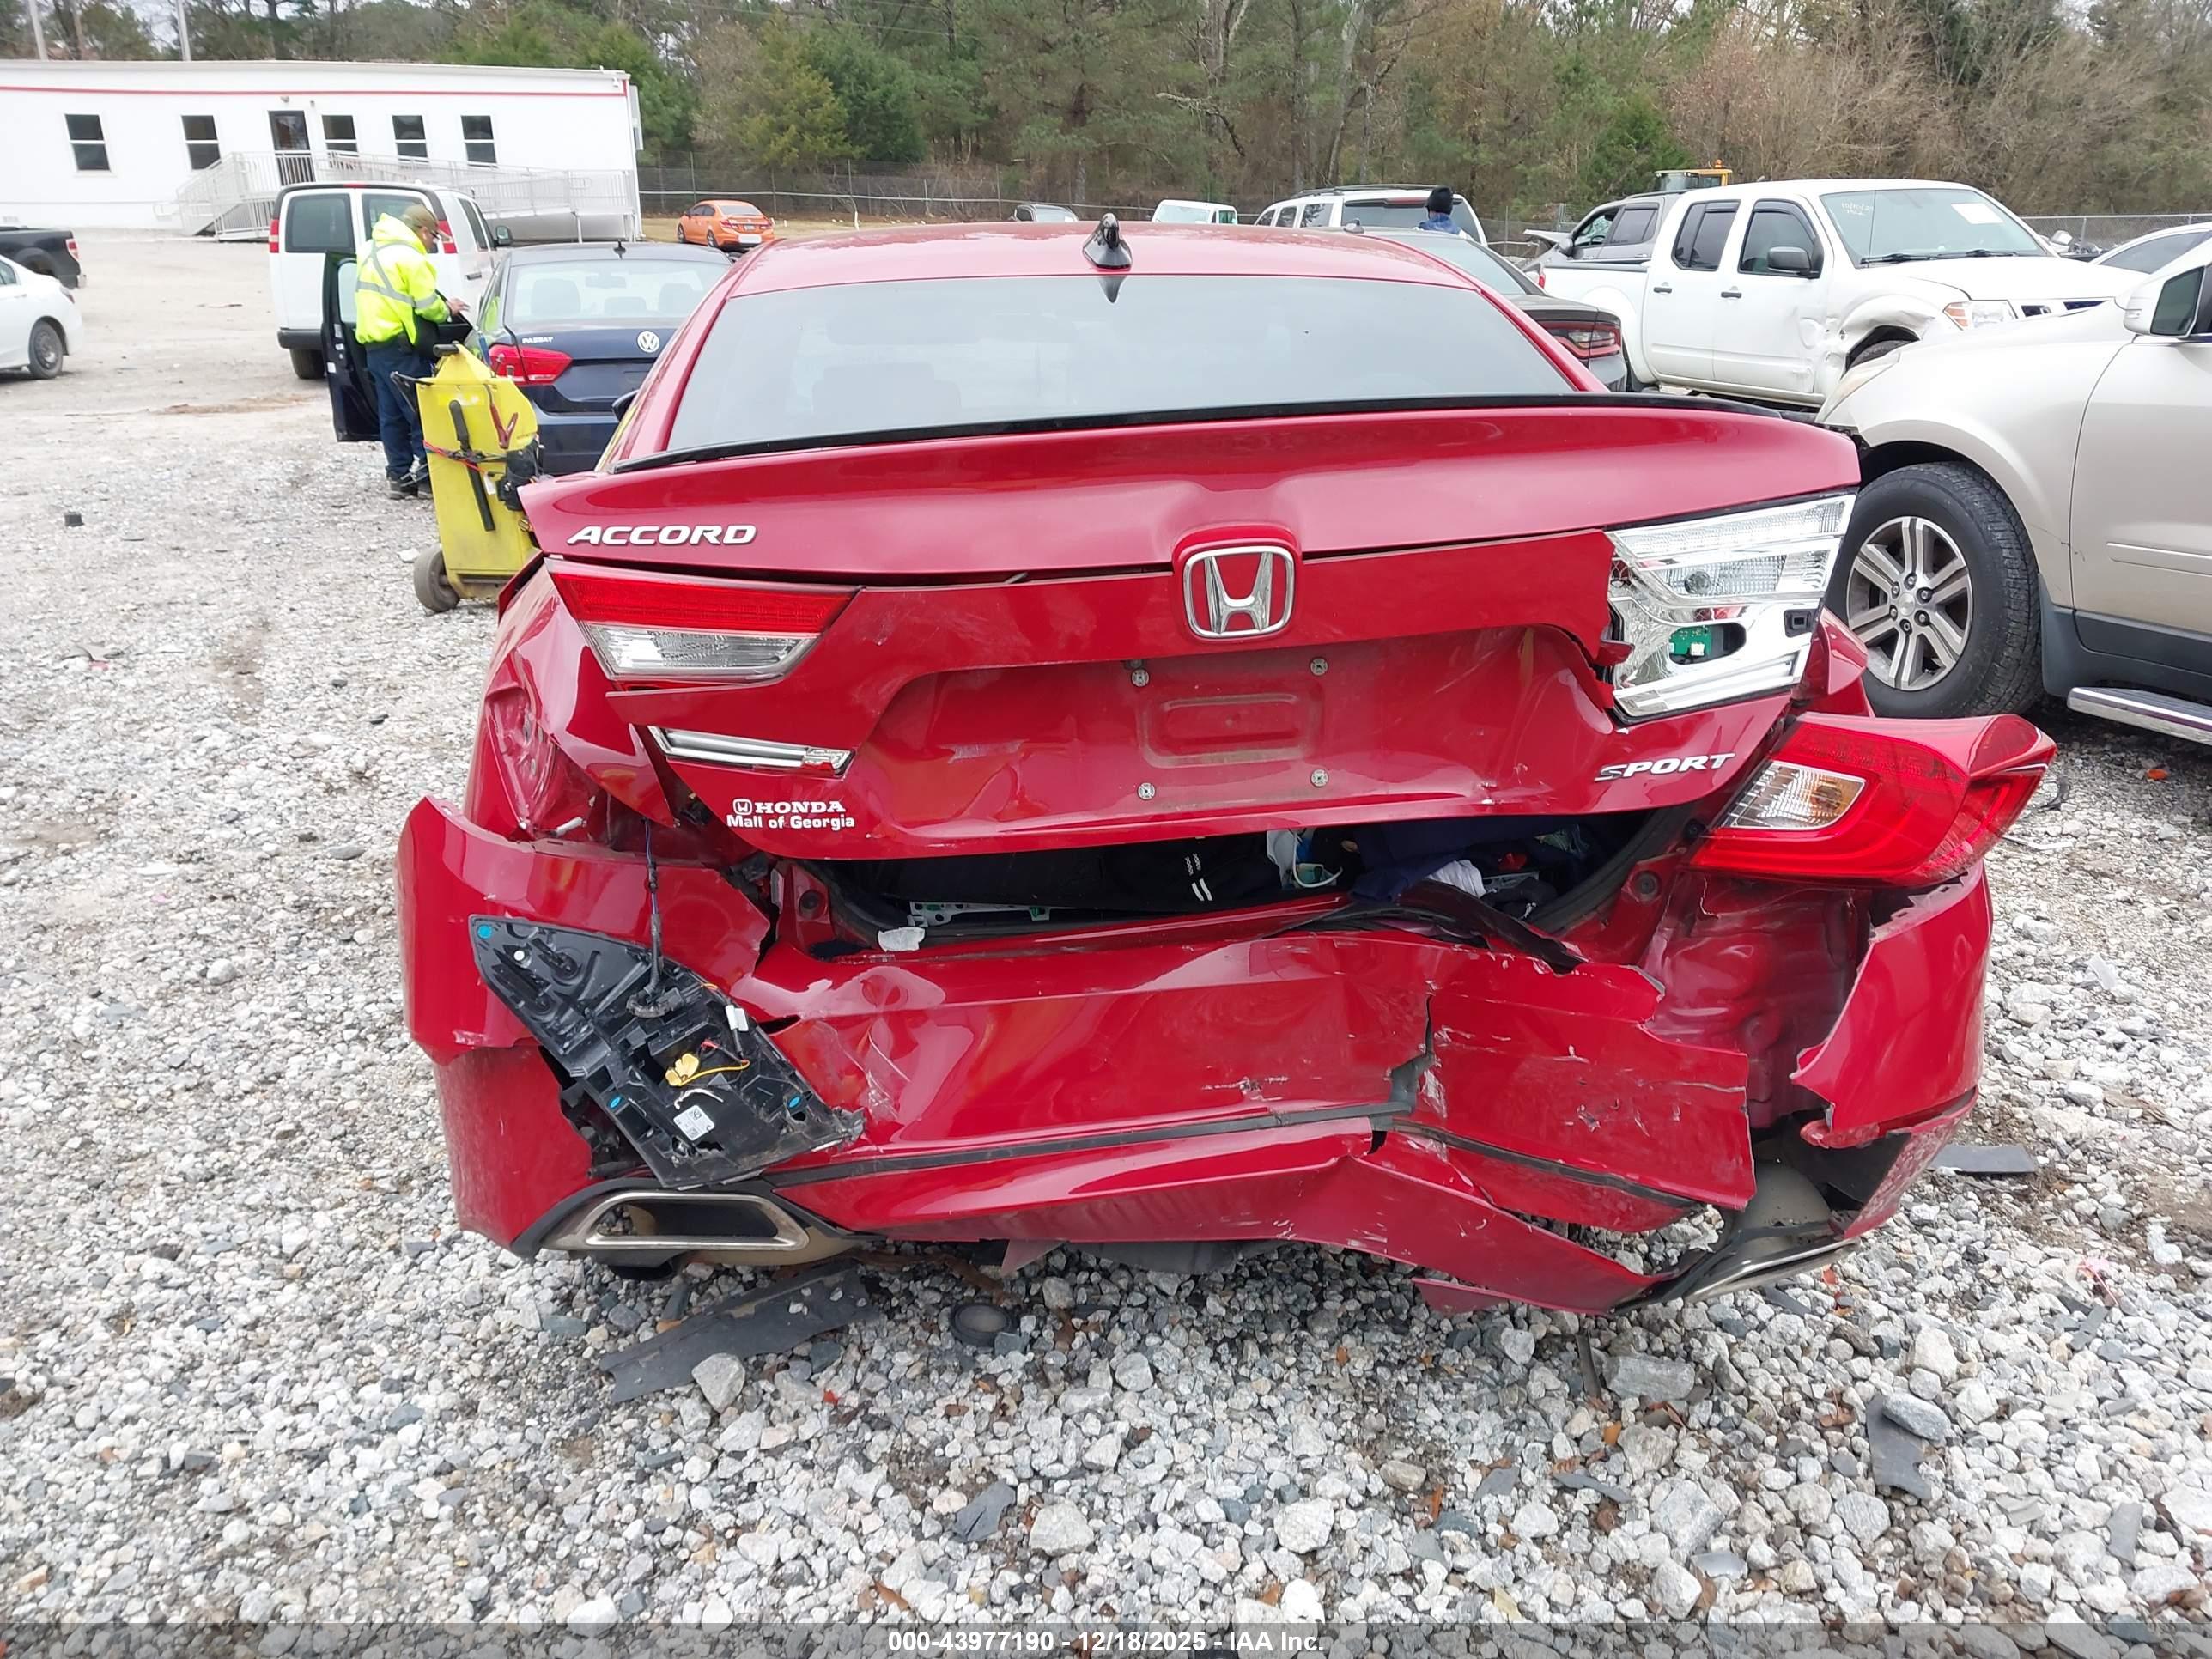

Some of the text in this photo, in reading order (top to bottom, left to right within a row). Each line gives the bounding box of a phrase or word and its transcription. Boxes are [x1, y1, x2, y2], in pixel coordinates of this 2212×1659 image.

[566, 525, 757, 546] ACCORD
[1594, 752, 1736, 782] SPORT
[754, 800, 847, 814] HONDA
[726, 814, 855, 831] Mall of Georgia
